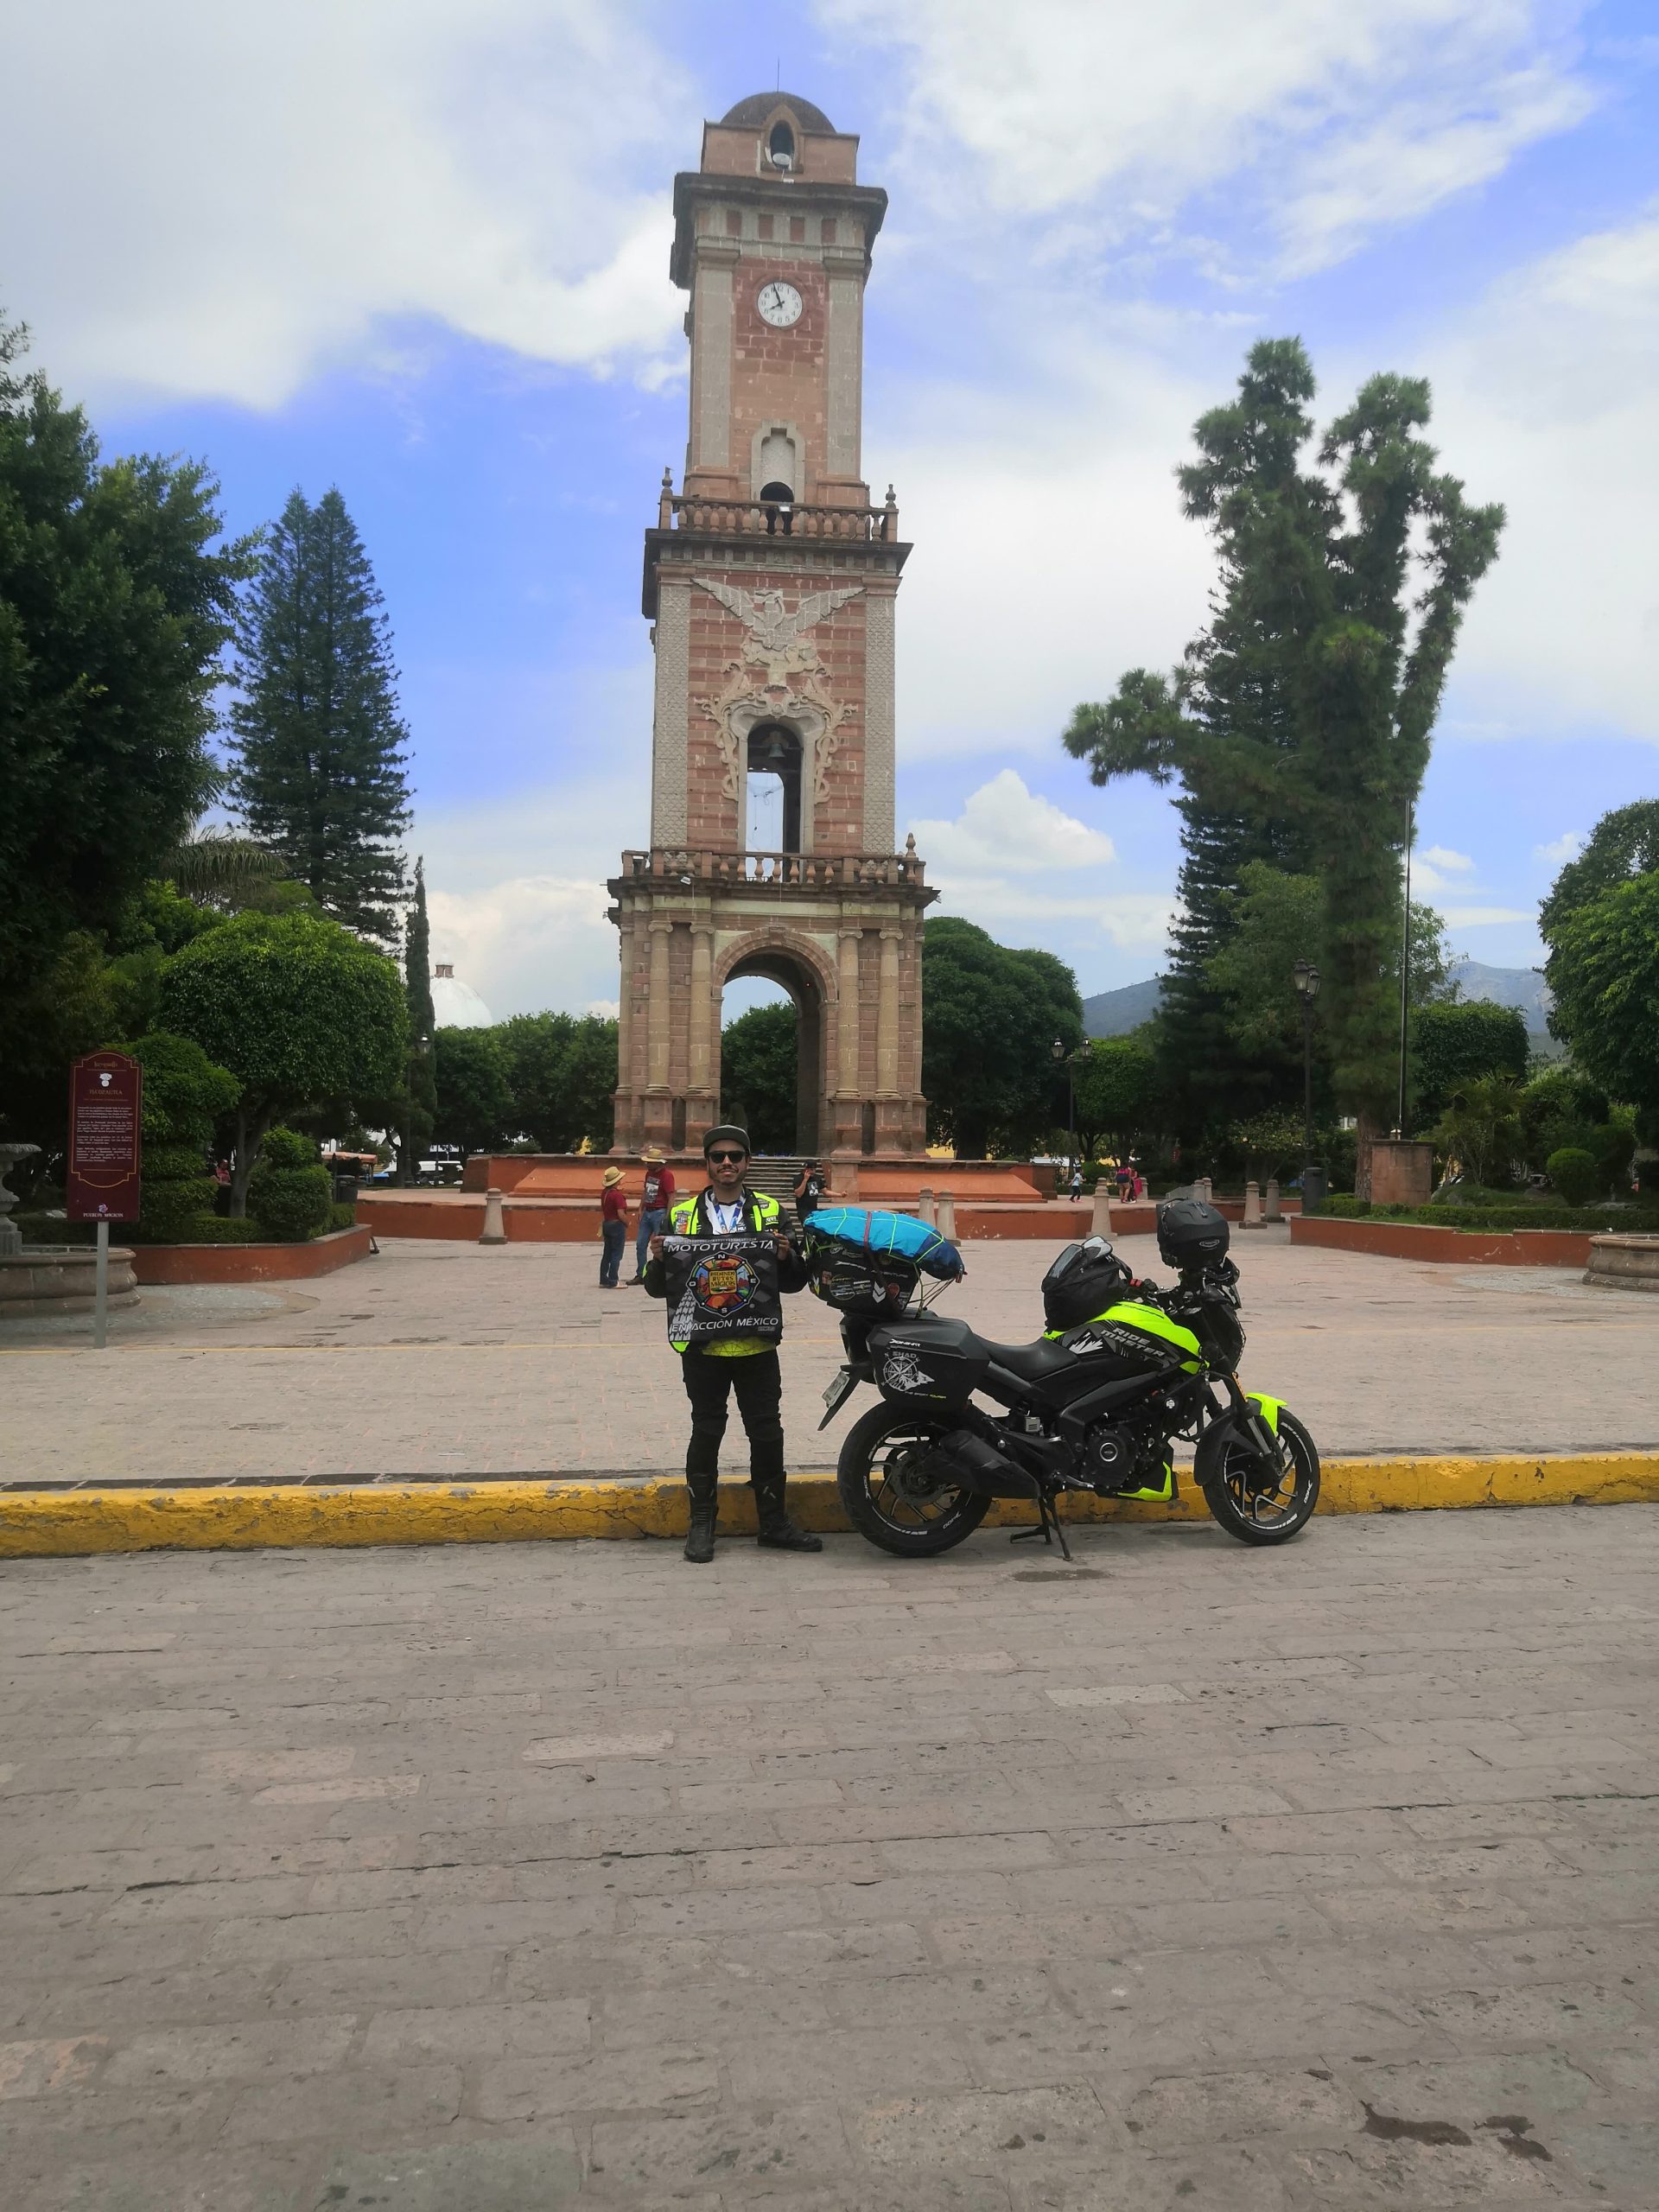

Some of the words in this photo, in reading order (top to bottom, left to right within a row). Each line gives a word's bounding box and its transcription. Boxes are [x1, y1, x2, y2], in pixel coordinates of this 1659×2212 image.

[668, 1240, 774, 1253] MOTOTURISTA
[691, 1319, 733, 1332] ACCIÓN
[736, 1316, 779, 1326] MÉXICO
[1100, 1329, 1166, 1357] MASTER
[1113, 1327, 1151, 1345] RIDE
